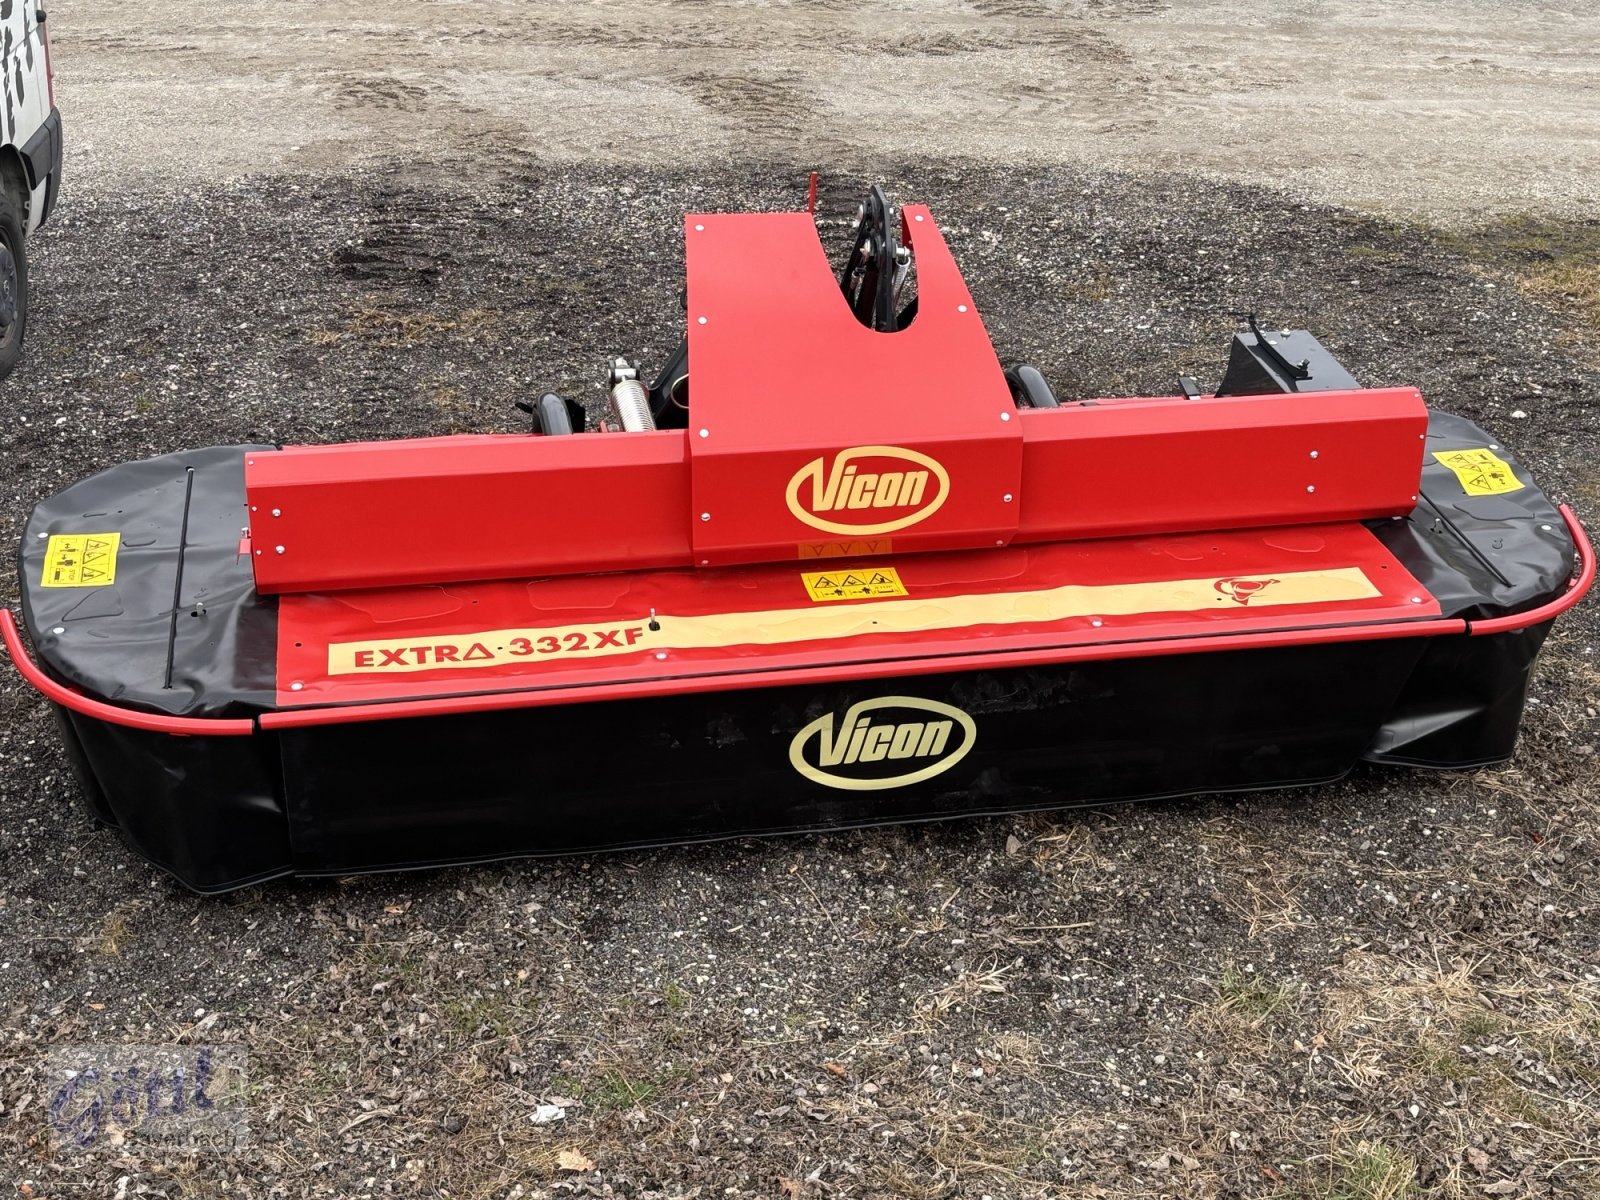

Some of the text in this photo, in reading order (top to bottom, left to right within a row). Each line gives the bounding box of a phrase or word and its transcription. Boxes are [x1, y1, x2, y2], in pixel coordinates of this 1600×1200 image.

[810, 446, 934, 515] Vicon
[509, 627, 643, 657] 332XF
[817, 696, 956, 769] Vicon
